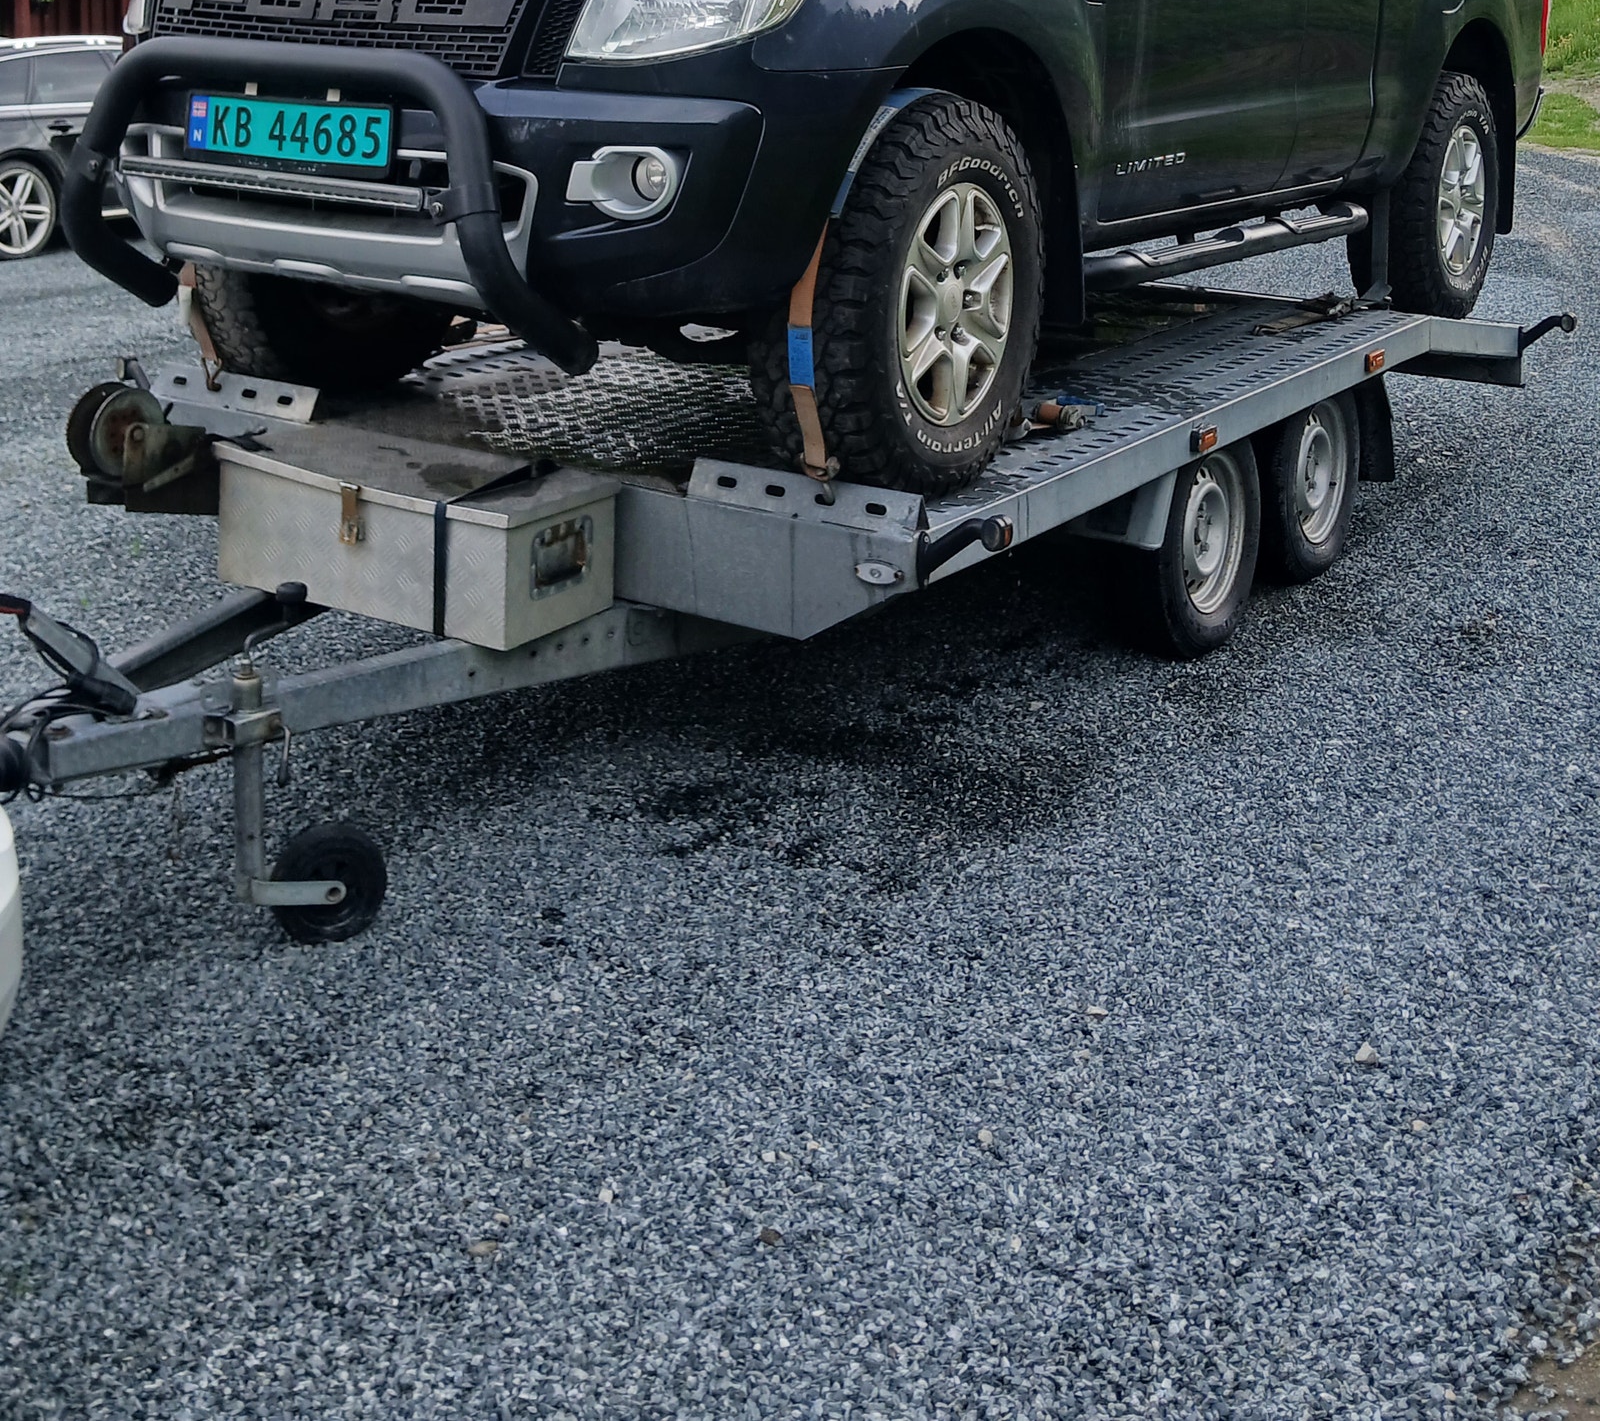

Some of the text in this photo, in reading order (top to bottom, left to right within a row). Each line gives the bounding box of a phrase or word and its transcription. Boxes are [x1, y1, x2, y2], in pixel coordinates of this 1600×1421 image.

[193, 129, 202, 142] N
[211, 104, 382, 159] KB 44685
[1115, 151, 1187, 176] LIMITED
[936, 156, 1025, 218] BFGoodrich
